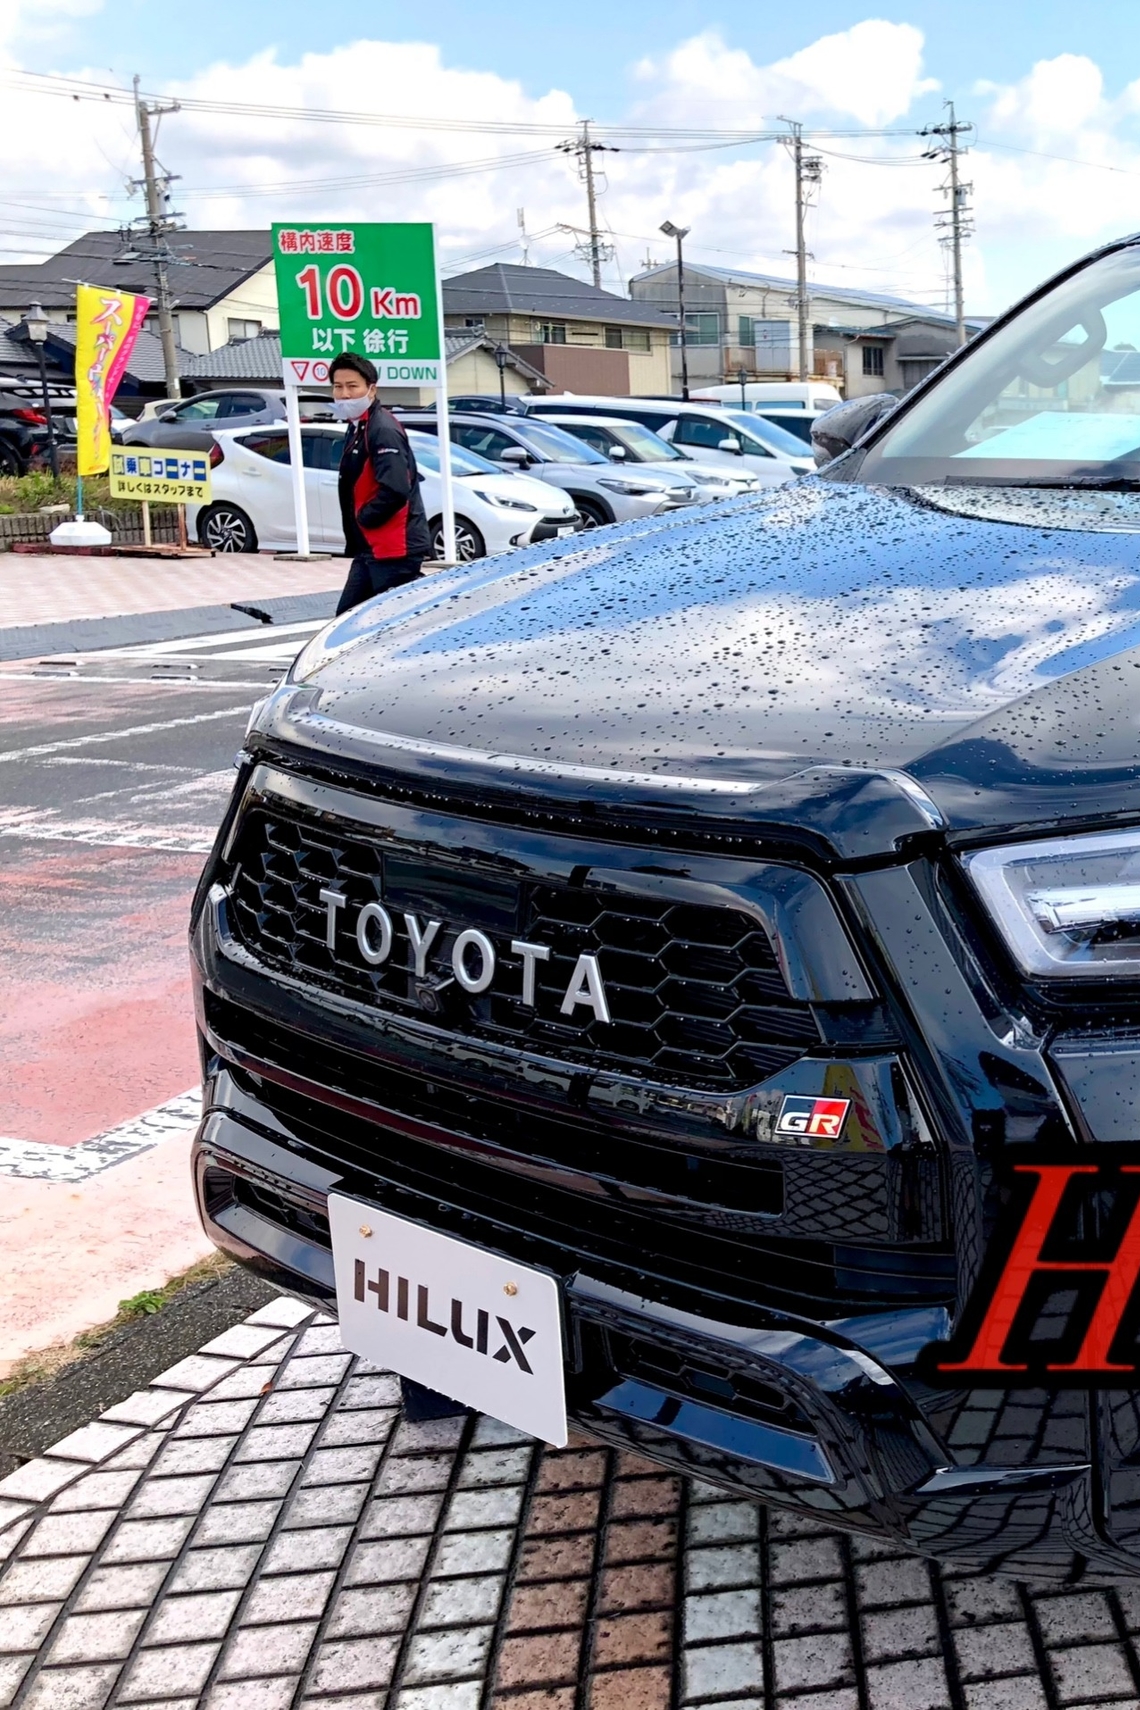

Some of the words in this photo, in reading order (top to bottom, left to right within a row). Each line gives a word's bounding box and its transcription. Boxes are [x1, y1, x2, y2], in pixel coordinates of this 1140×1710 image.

[280, 230, 354, 253] 構内速度
[297, 265, 363, 319] 10
[372, 289, 419, 317] Km
[312, 328, 356, 353] 以下
[363, 328, 409, 354] 徐行
[387, 366, 437, 380] DOWN
[319, 889, 611, 1024] TOYOTA
[780, 1111, 840, 1135] GR
[354, 1258, 538, 1375] HILUX
